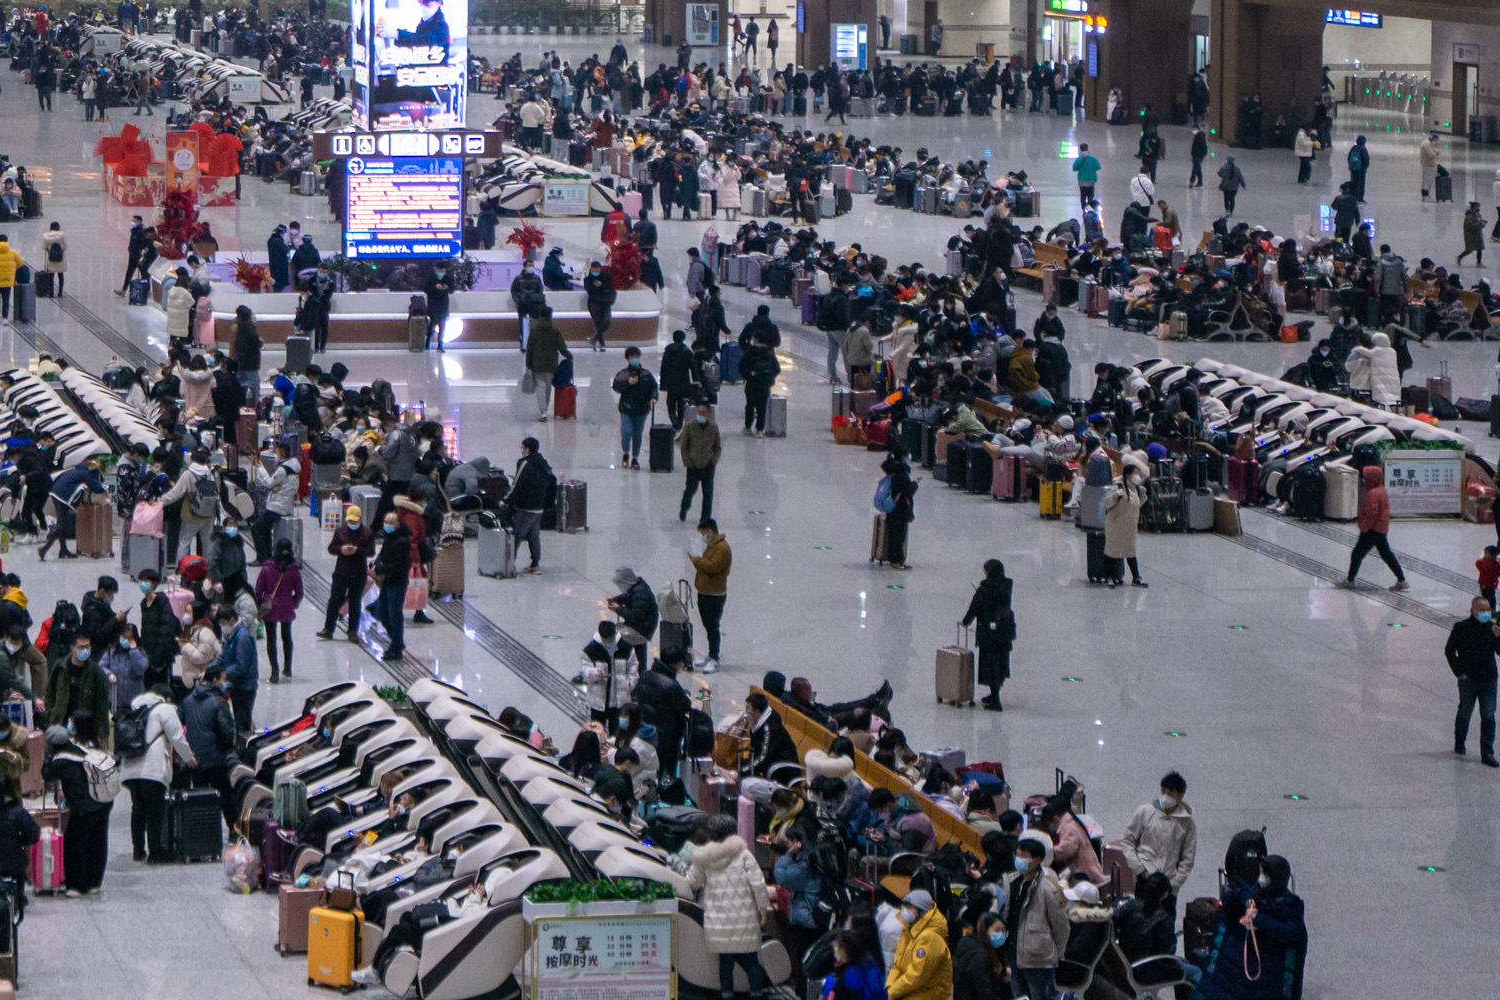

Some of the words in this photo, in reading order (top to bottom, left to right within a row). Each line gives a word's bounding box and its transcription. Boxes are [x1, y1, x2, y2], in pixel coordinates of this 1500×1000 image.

[552, 935, 592, 953] 尊享
[546, 953, 599, 969] 按摩时光
